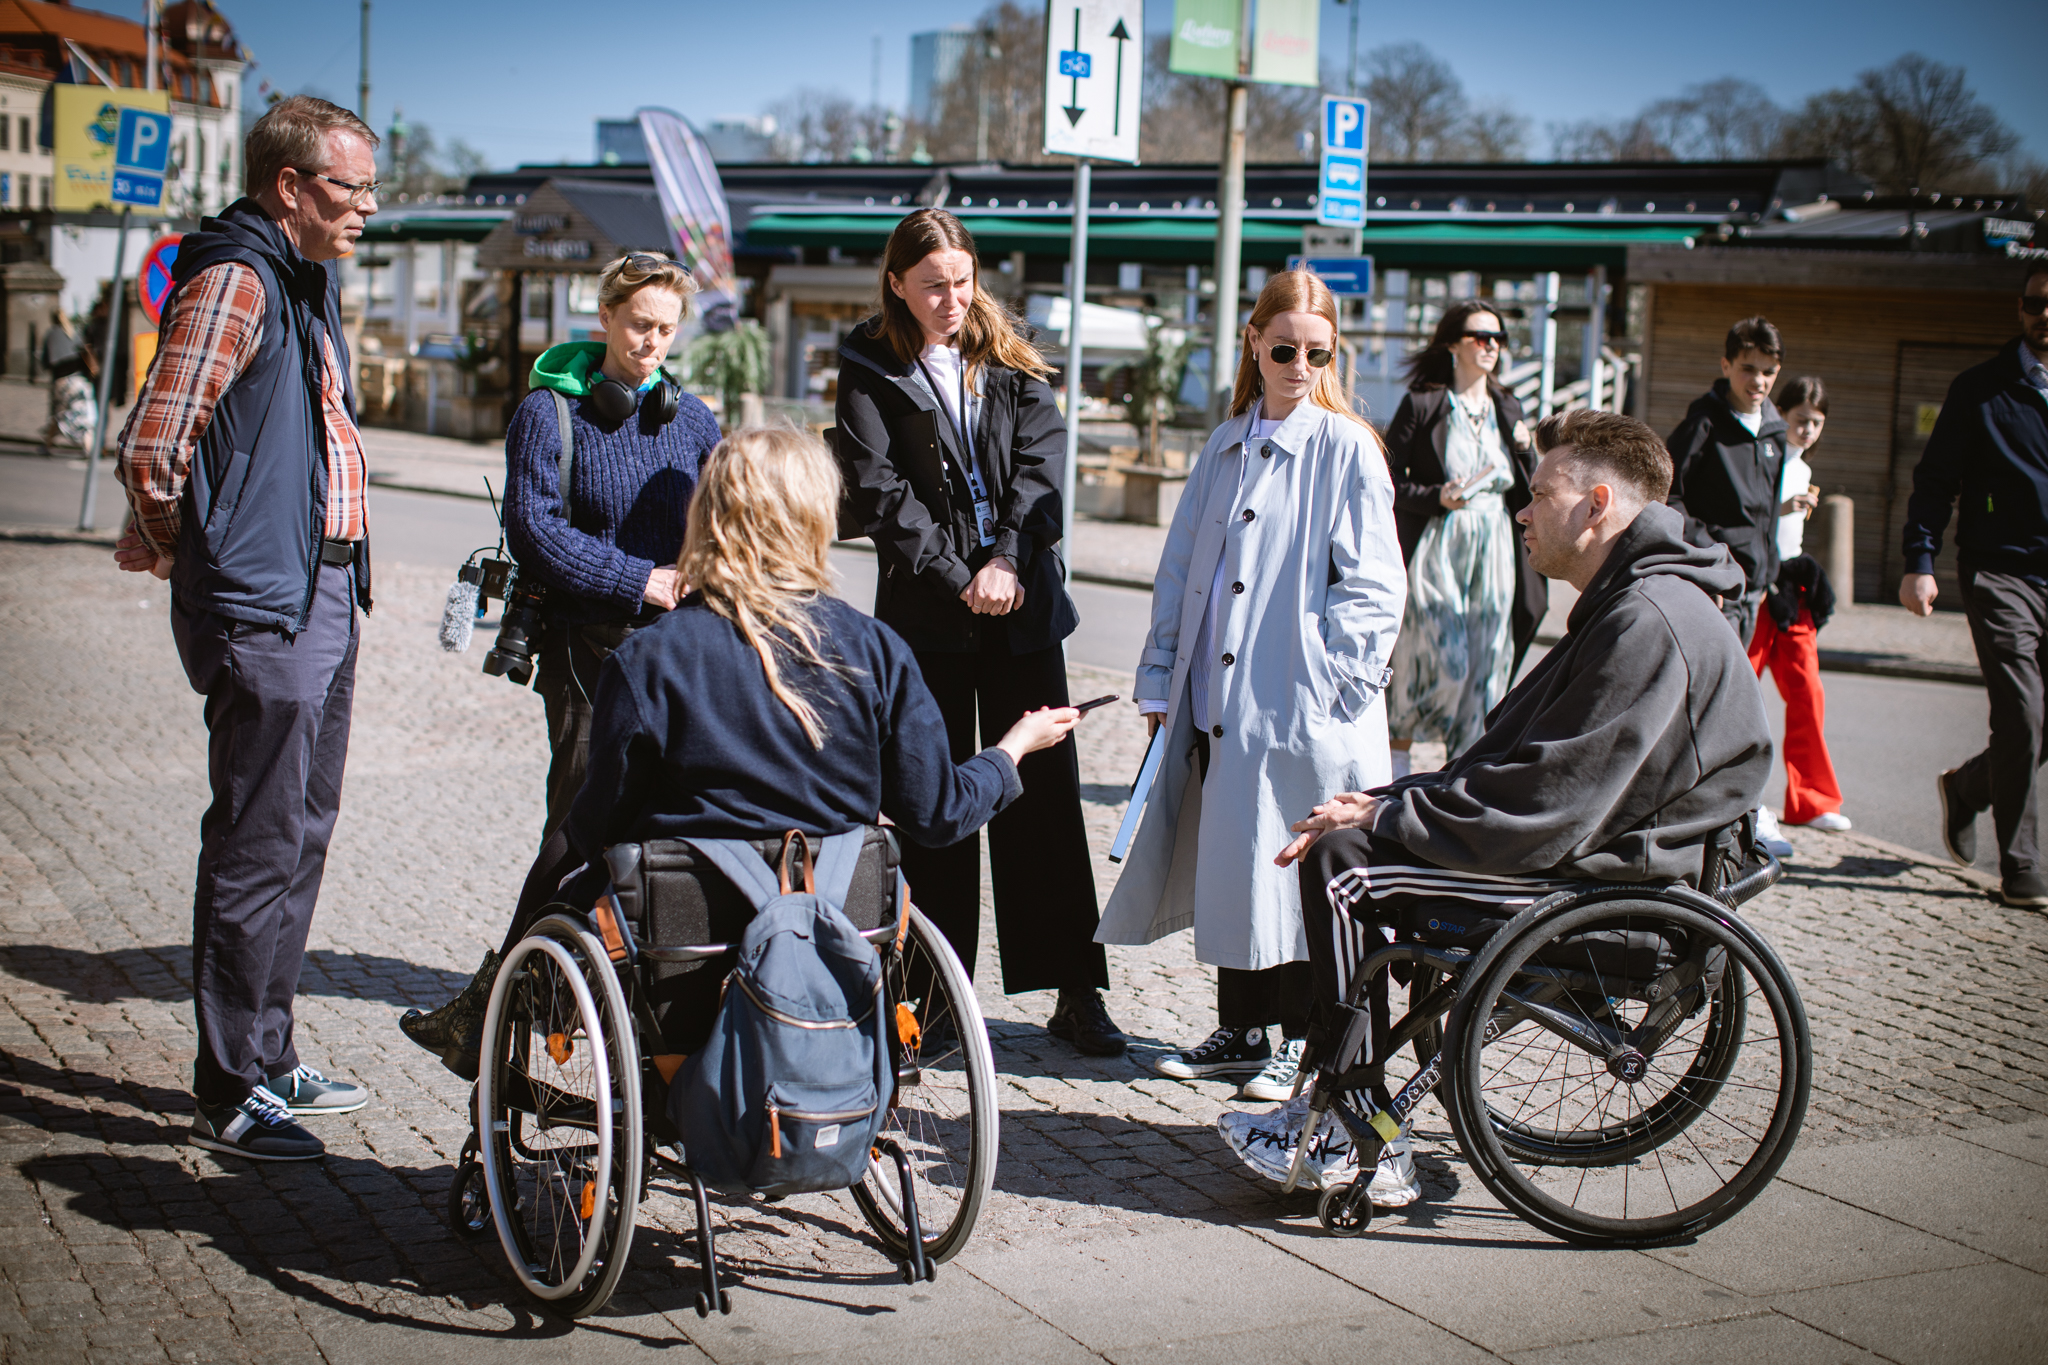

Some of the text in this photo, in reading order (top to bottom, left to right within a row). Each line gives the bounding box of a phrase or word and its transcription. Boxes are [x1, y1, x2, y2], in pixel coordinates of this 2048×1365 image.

[131, 116, 159, 163] P
[1334, 103, 1359, 147] P
[1440, 921, 1466, 935] STAR
